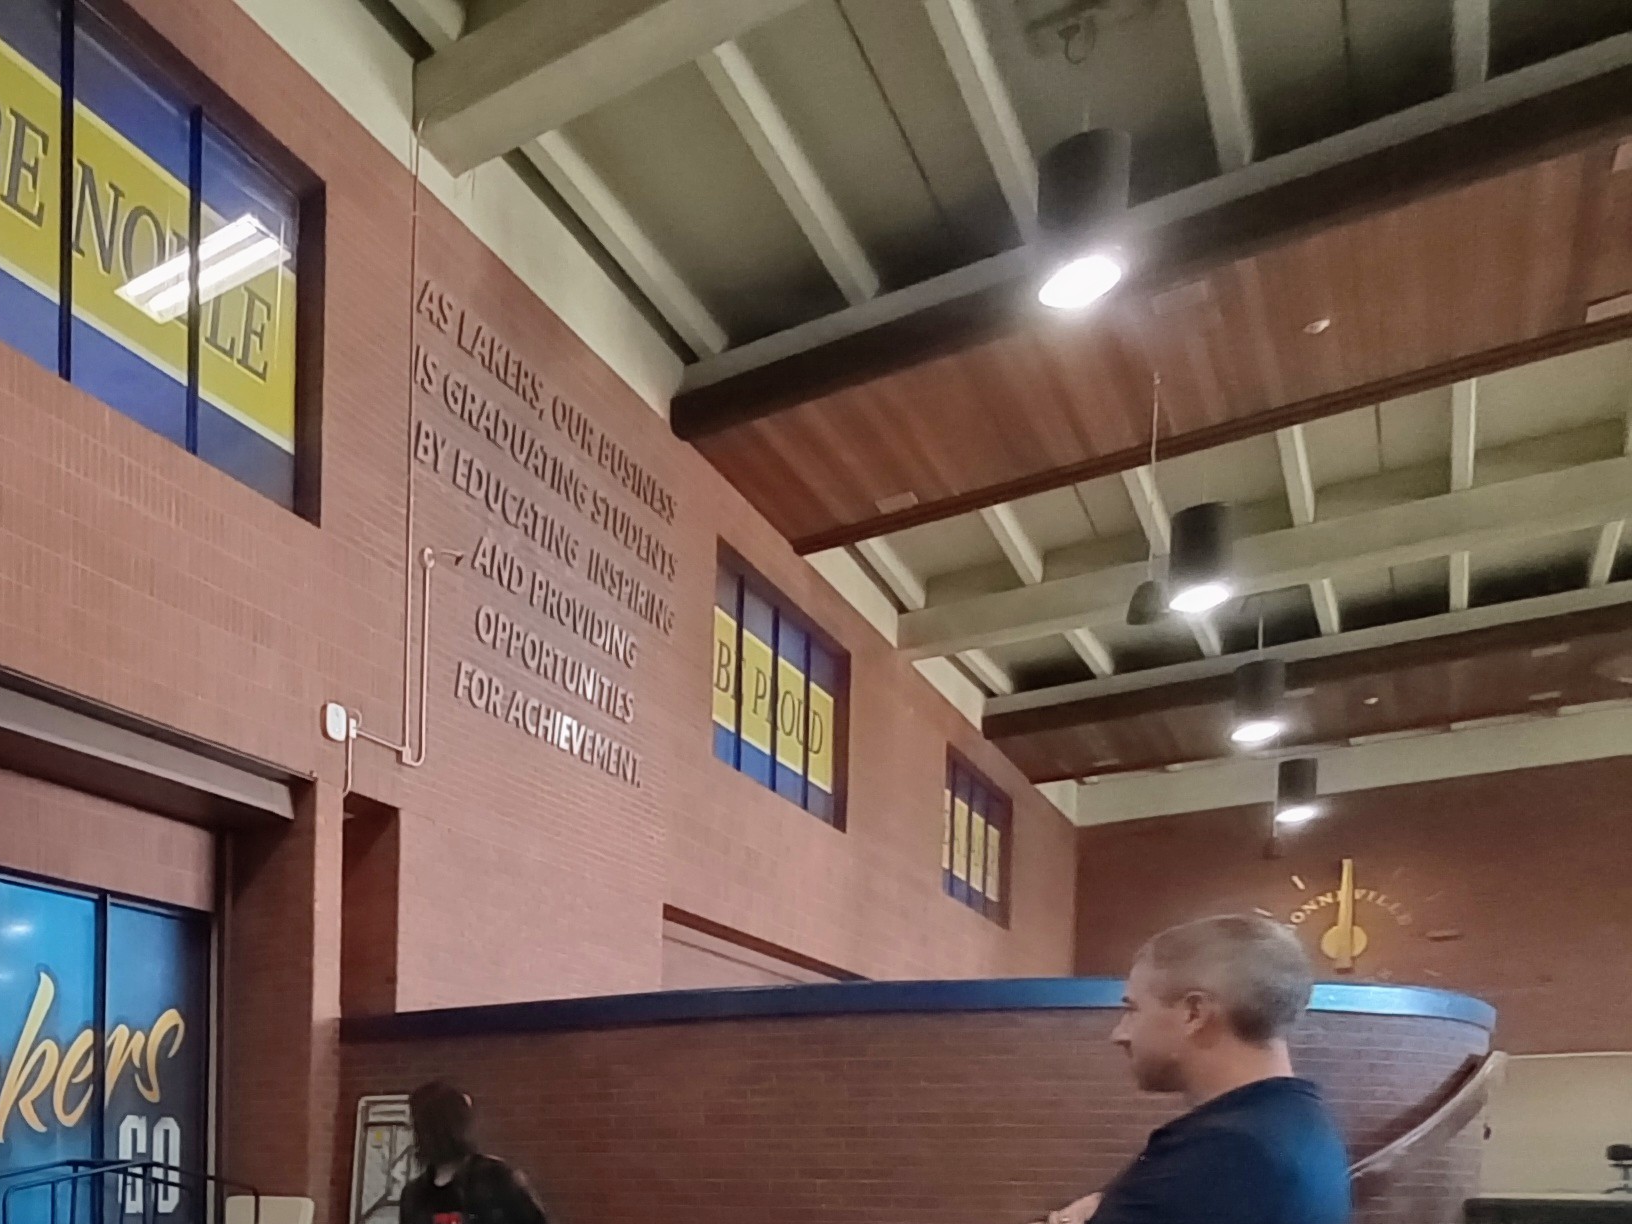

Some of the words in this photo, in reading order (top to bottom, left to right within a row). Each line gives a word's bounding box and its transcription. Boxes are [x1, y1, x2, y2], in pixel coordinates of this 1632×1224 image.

[70, 158, 272, 383] NOLE
[414, 344, 438, 395] IS
[443, 373, 589, 513] GRADUATING
[591, 489, 679, 583] STUDENTS
[416, 279, 454, 335] AS
[457, 309, 544, 421] LAKERS,
[552, 394, 595, 457] OUR
[597, 432, 678, 526] BUSINESS
[414, 420, 448, 474] BY
[453, 448, 580, 569] EDUCATING
[587, 548, 676, 637] INSPIRING
[471, 536, 524, 595] AND
[530, 570, 639, 669] PROVIDING
[475, 604, 635, 724] OPPORTUNITIES
[455, 661, 505, 718] FOR
[714, 640, 746, 702] B
[752, 667, 824, 755] POUD
[1286, 887, 1414, 930] ONNVILLE
[118, 1114, 181, 1215] GO
